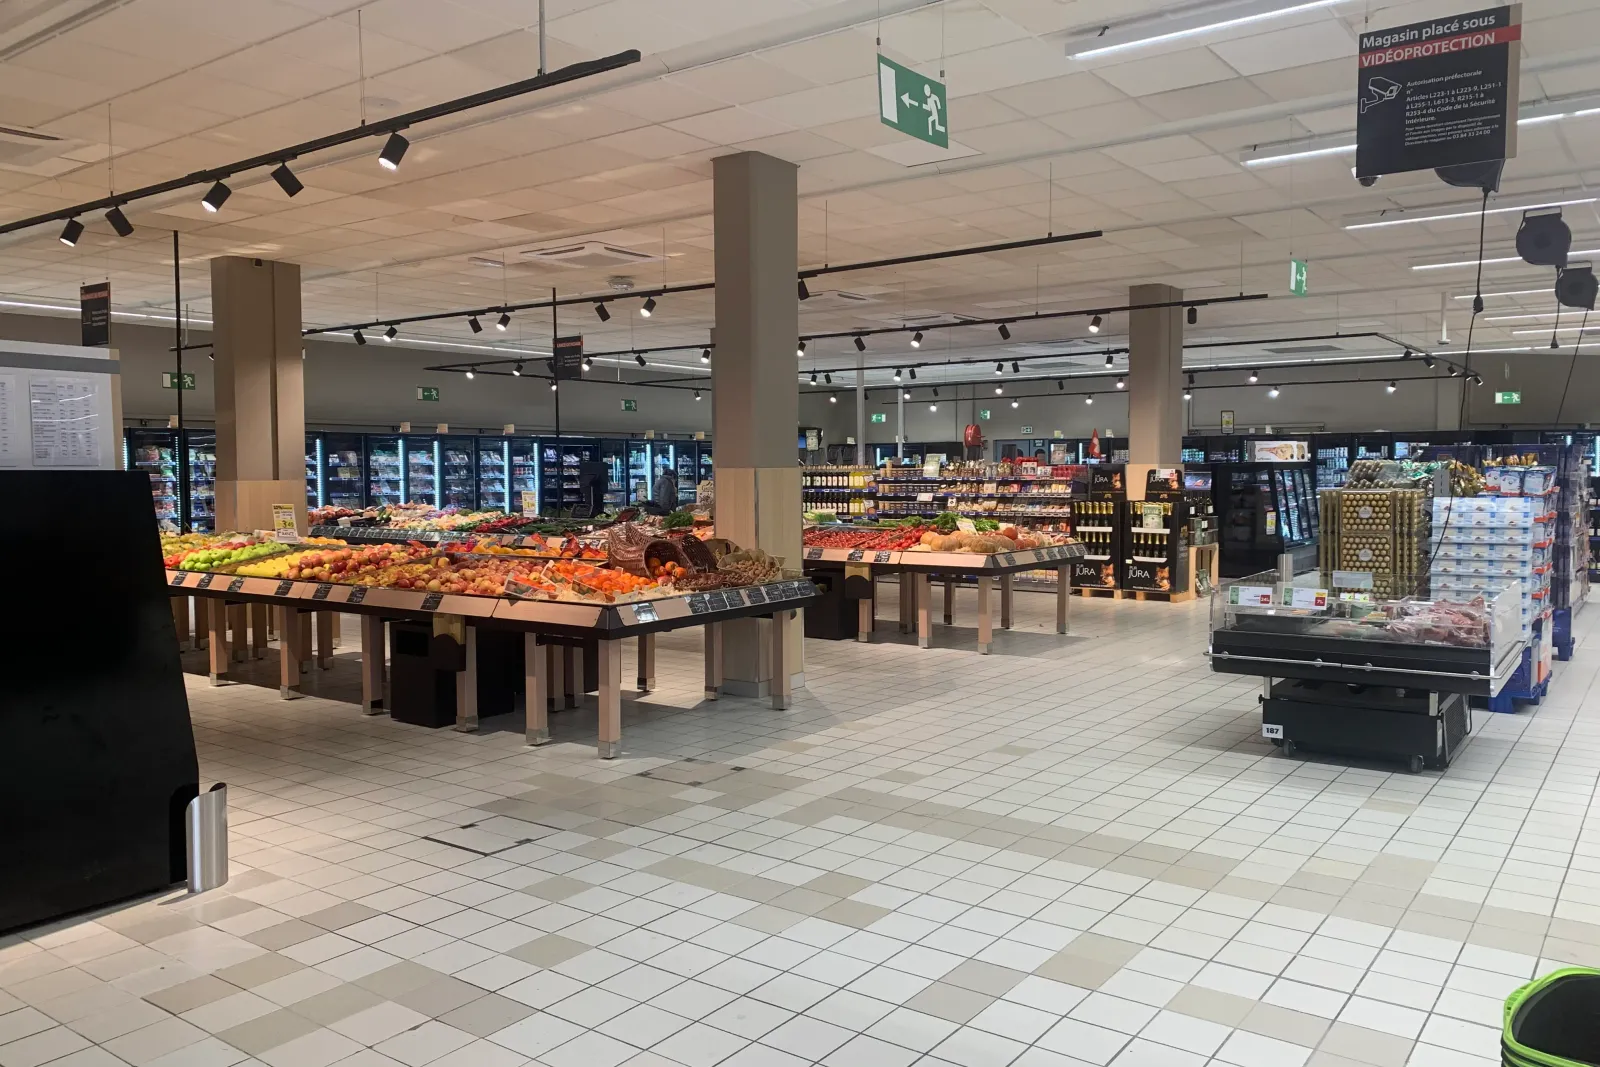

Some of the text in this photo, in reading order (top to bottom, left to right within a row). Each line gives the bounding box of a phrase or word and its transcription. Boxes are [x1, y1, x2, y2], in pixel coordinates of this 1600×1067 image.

[1362, 15, 1496, 48] Magasin placé sous
[1362, 32, 1495, 67] VIDÉOPROTECTION
[1406, 70, 1482, 87] Autorisation préfectorale
[1430, 90, 1450, 98] L223-1
[1470, 98, 1496, 106] Sécurité
[1075, 567, 1096, 576] JURA
[1128, 569, 1150, 579] JURA
